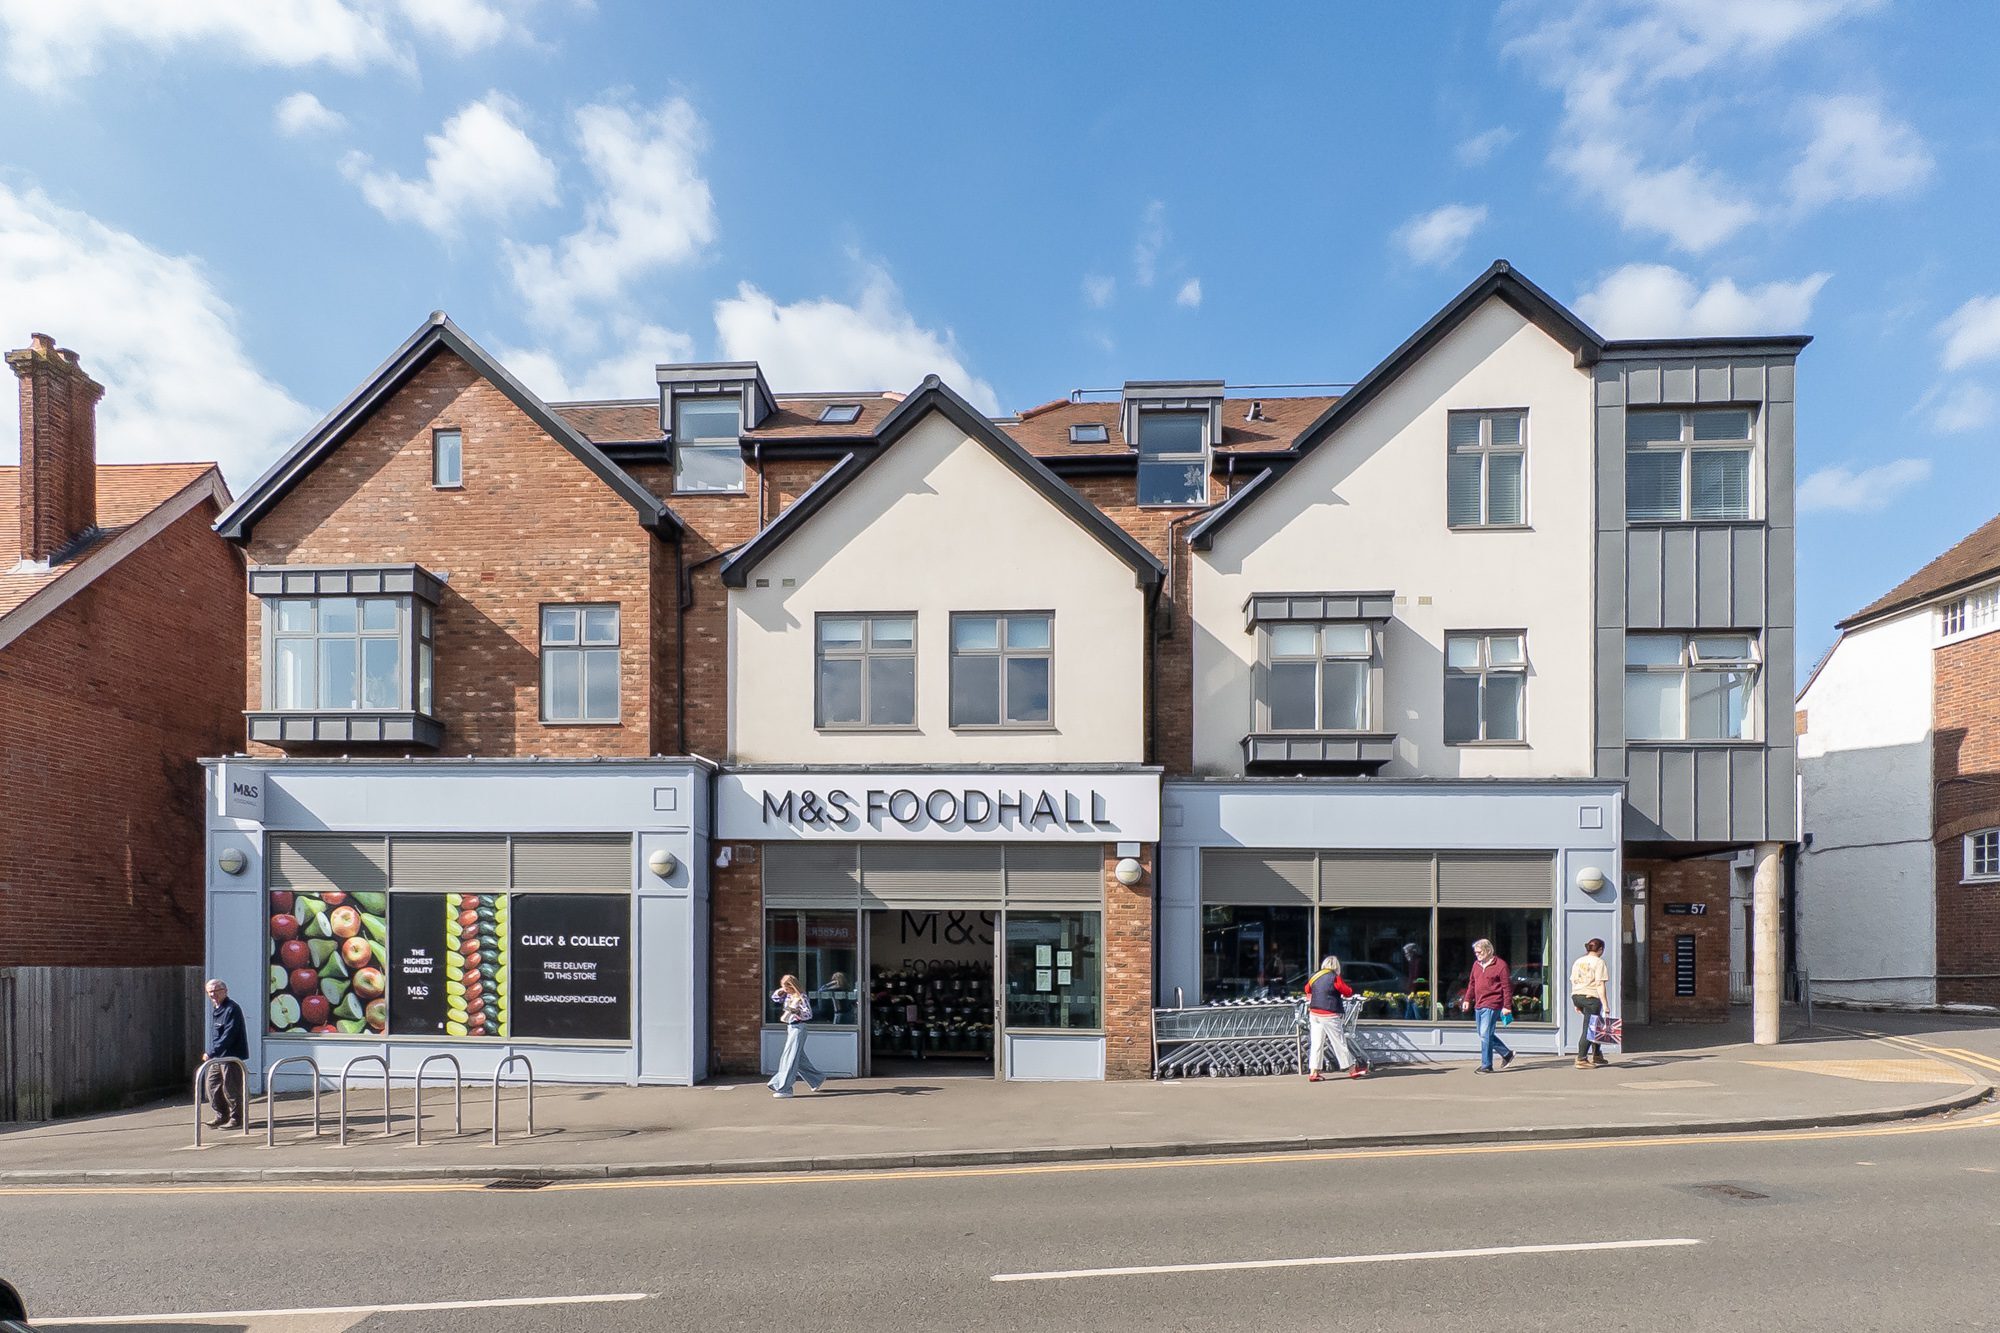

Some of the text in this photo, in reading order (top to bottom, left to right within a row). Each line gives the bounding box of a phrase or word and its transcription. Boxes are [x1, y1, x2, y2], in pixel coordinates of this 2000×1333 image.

[233, 782, 258, 799] M&S
[763, 789, 1111, 825] M&S FOODHALL
[1691, 904, 1706, 914] 57
[521, 935, 620, 947] CLICK & COLLECT
[403, 966, 433, 974] QUALITY
[543, 961, 597, 970] FREE DELIVERY
[543, 972, 597, 980] TO THIS STORE
[407, 986, 429, 996] M&S
[524, 995, 617, 1004] MARKSANDSPENCER.COM
